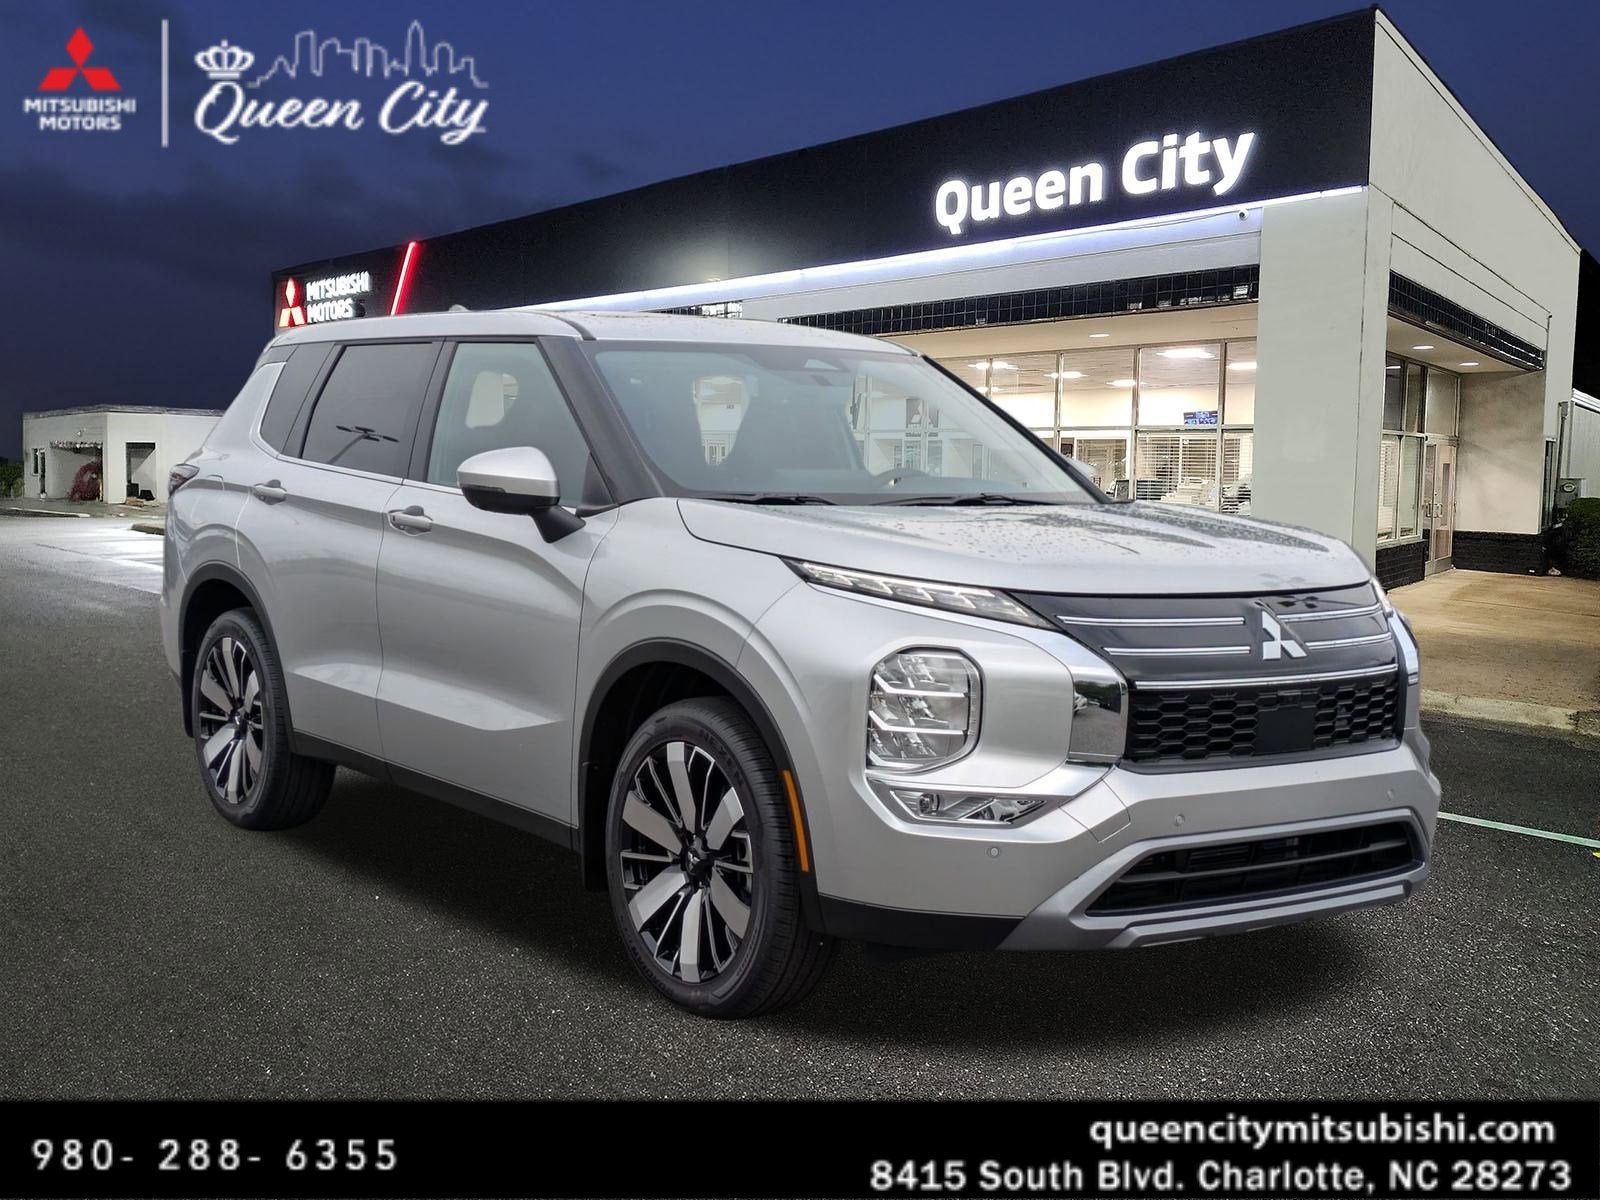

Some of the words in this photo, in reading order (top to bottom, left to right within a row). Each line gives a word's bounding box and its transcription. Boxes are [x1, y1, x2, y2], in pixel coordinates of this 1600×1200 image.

[935, 161, 1106, 235] Queen
[1121, 131, 1255, 196] City
[306, 271, 369, 300] MITSUBISHI
[307, 298, 354, 323] MOTORS
